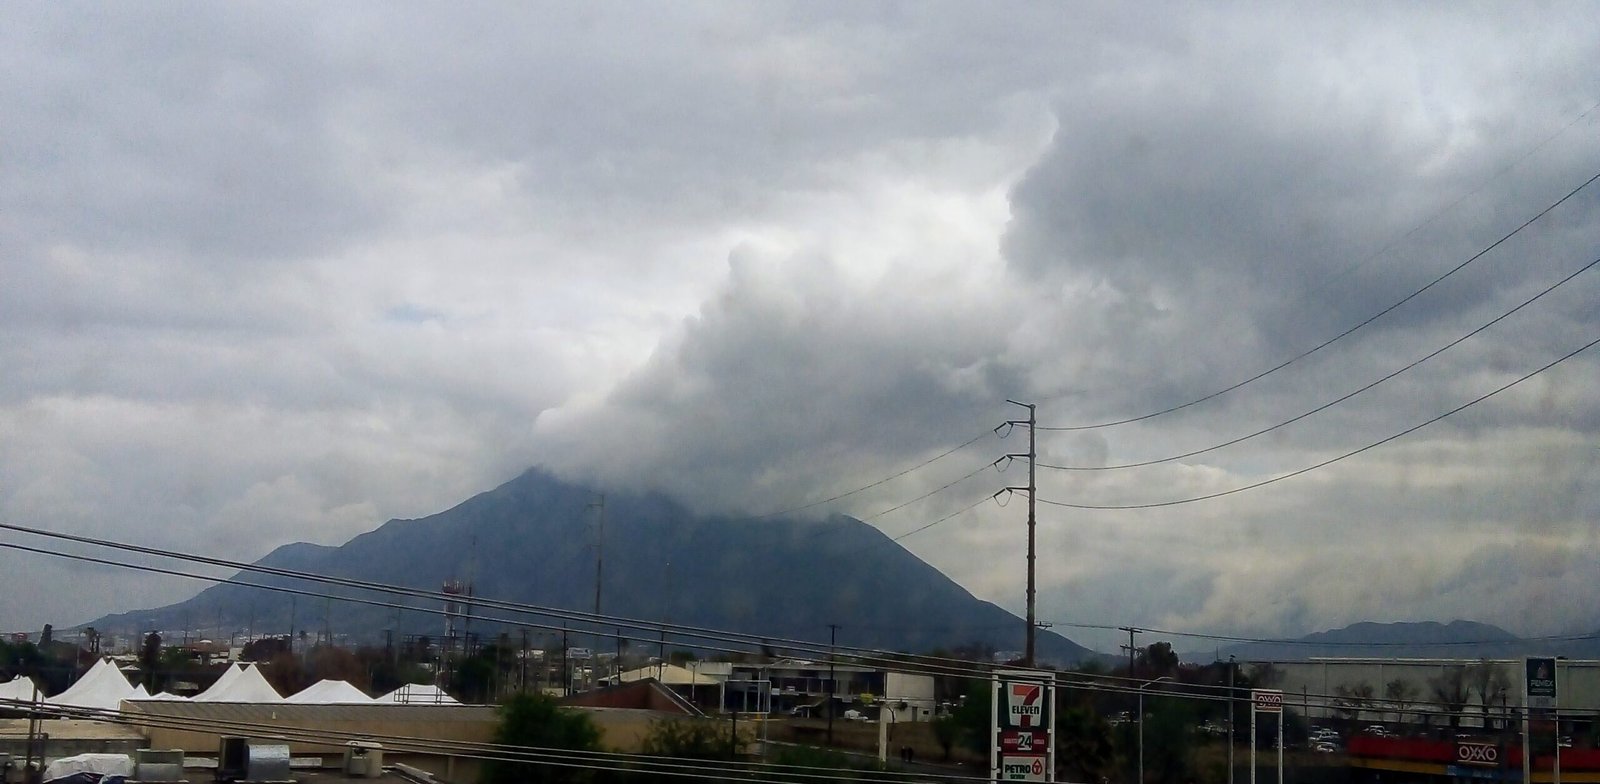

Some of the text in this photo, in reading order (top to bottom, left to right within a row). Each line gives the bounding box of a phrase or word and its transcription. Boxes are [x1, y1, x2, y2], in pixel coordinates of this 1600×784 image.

[1012, 685, 1040, 727] 7
[1018, 735, 1032, 749] 24
[1459, 745, 1497, 761] OXXO
[1004, 764, 1031, 774] PETRO
